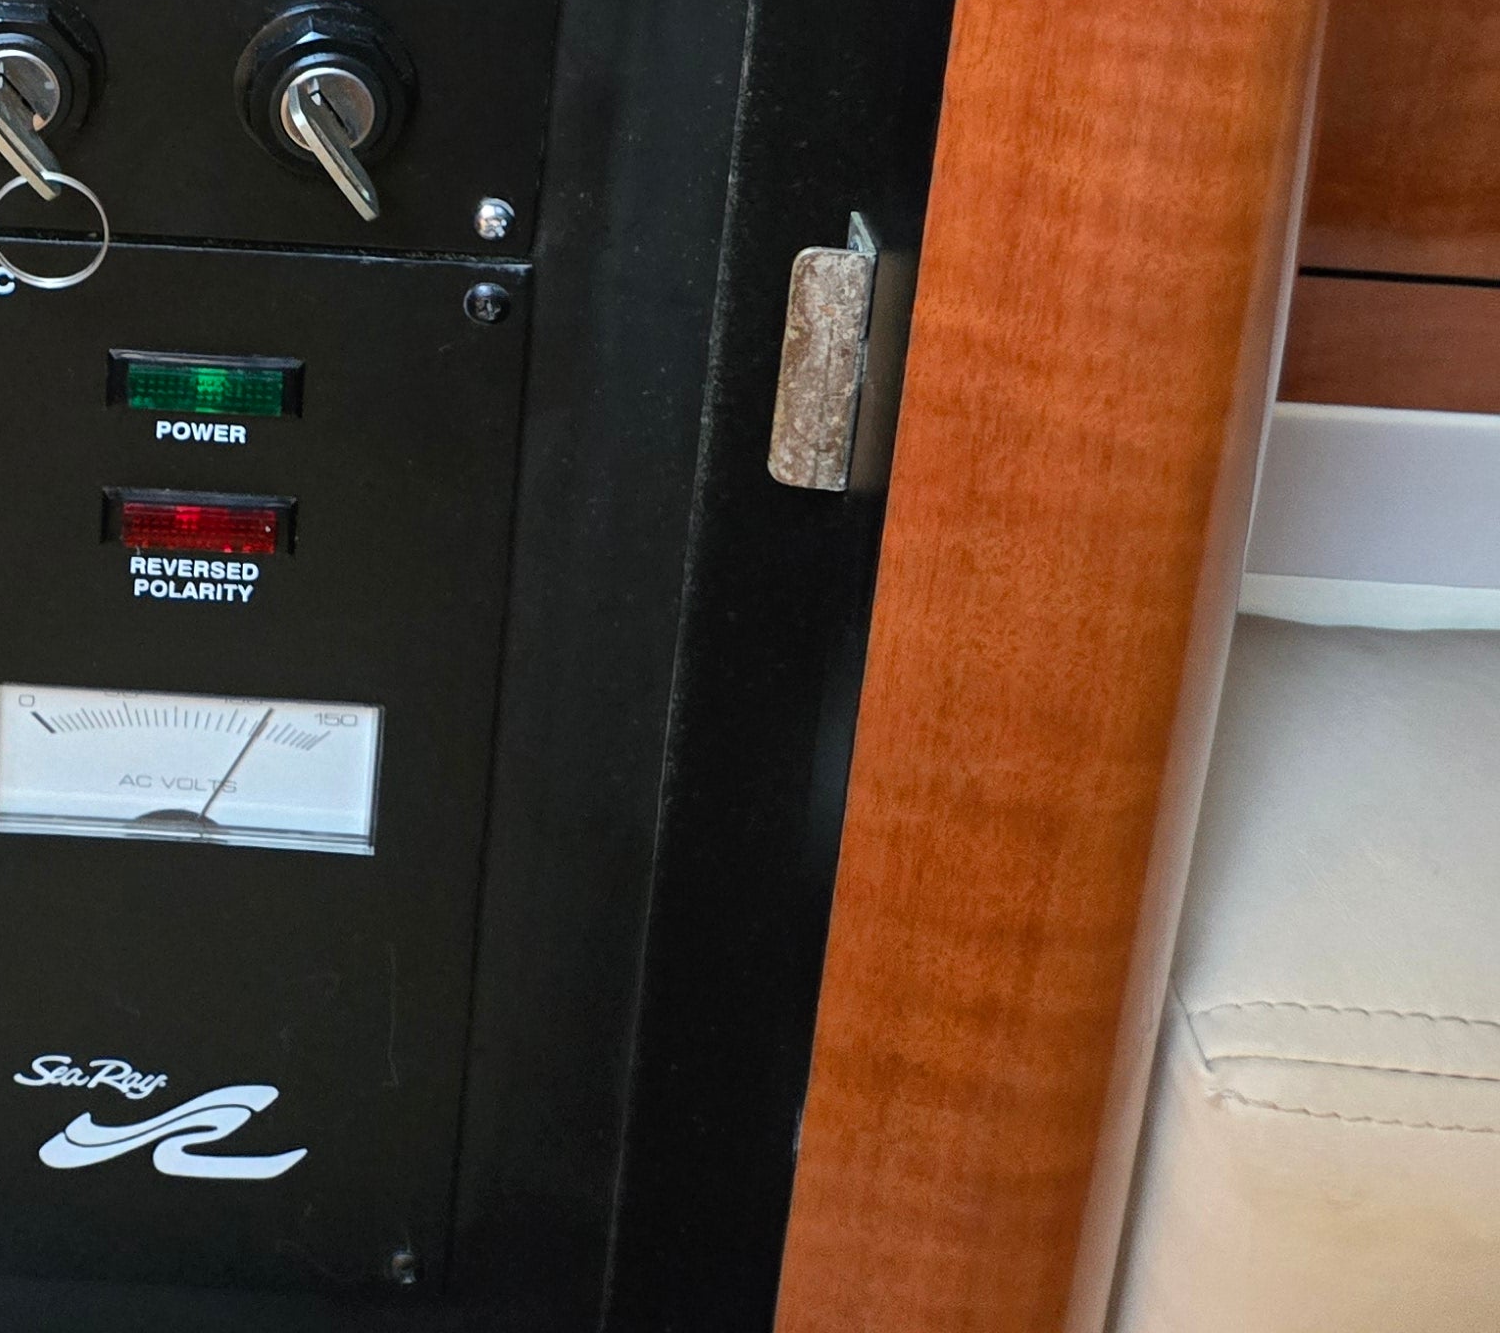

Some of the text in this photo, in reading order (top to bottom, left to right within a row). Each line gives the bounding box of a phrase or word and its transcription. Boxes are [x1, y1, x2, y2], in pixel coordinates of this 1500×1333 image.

[155, 420, 247, 444] POWER
[130, 556, 260, 581] REVERSED
[133, 579, 254, 603] POLARITY
[314, 713, 358, 727] 150
[118, 774, 238, 793] AC VOLTS
[13, 1055, 90, 1086] Sea
